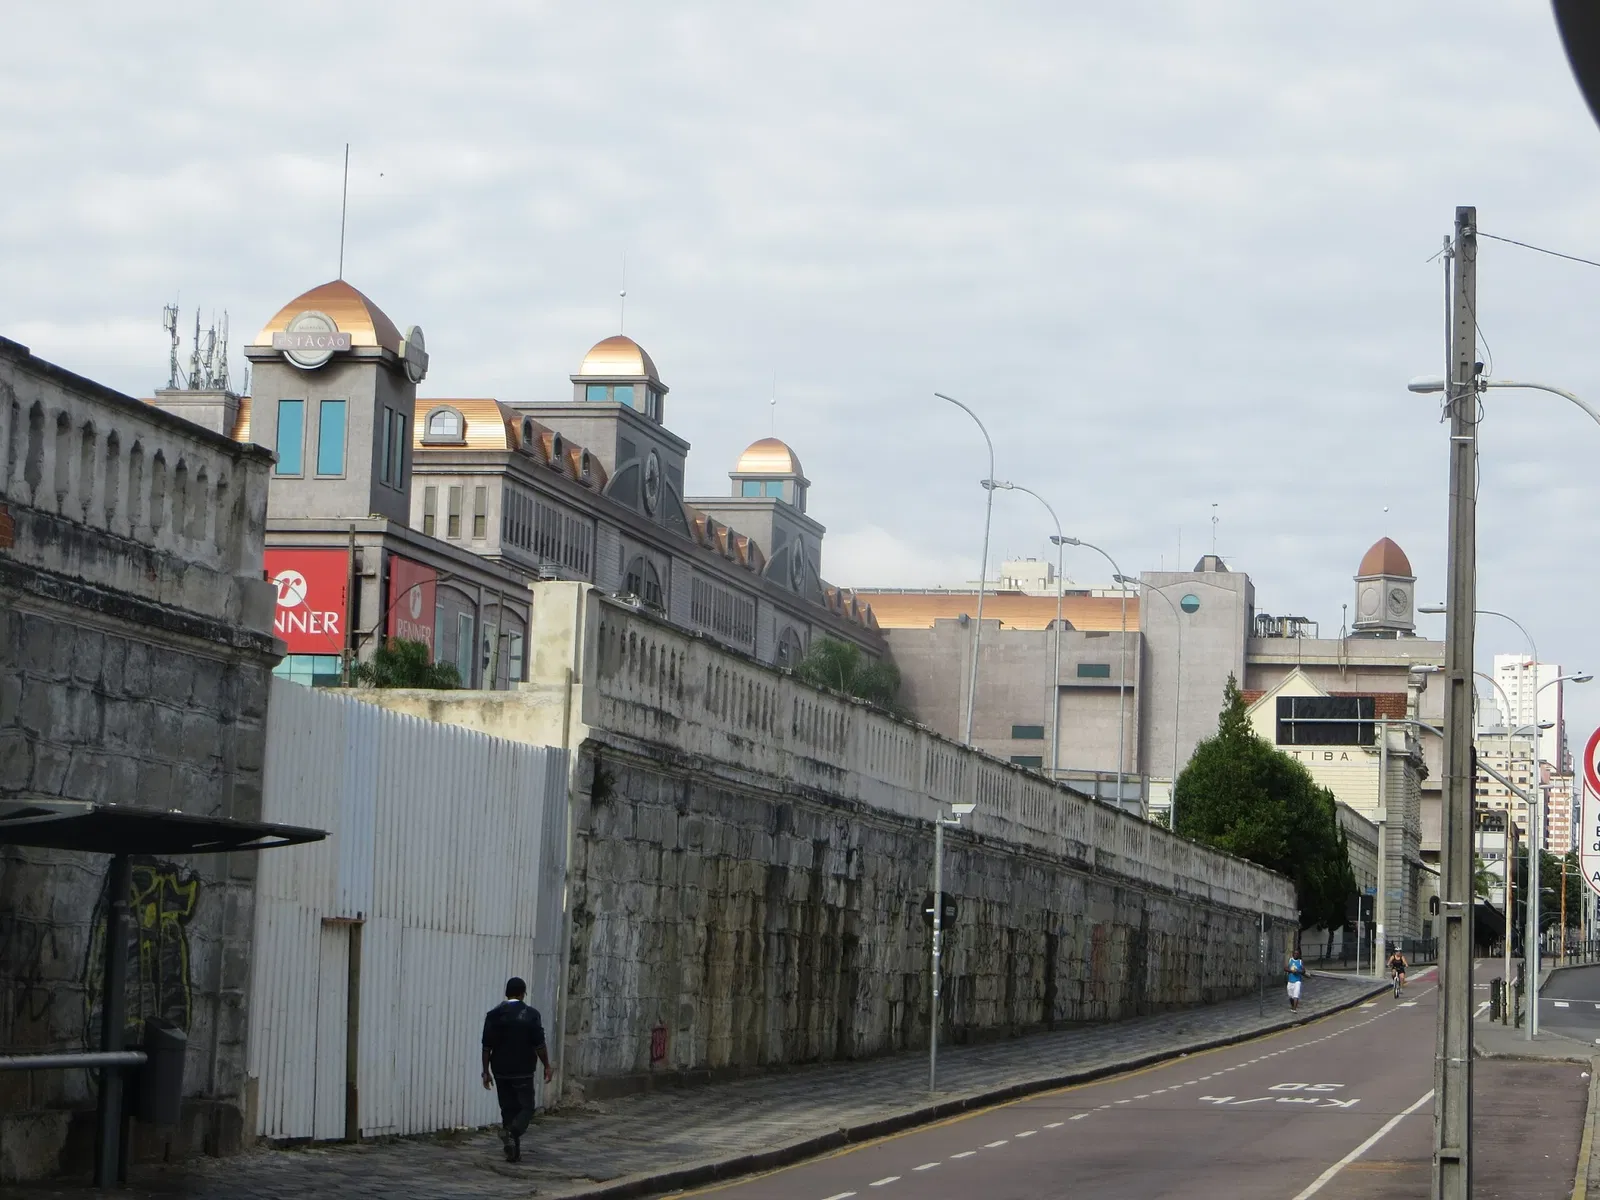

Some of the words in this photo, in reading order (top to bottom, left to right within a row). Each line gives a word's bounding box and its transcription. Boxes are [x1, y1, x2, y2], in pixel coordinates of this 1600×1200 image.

[274, 611, 339, 633] NNER
[1293, 751, 1352, 761] TIBA.
[1268, 1083, 1345, 1091] 30
